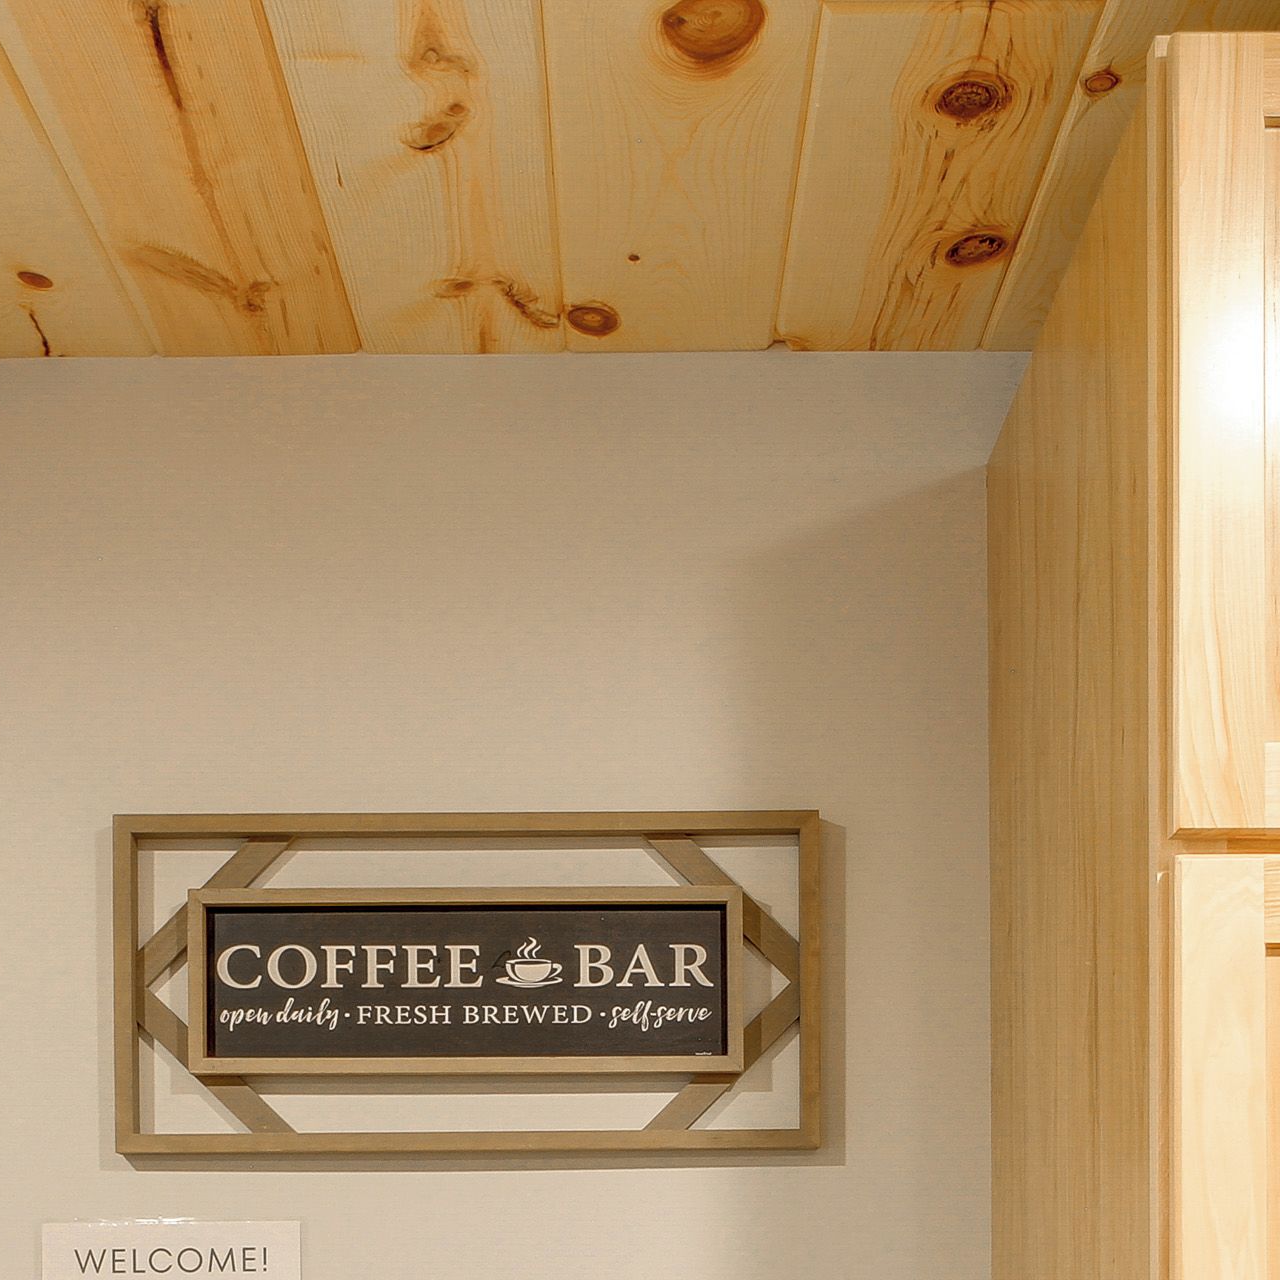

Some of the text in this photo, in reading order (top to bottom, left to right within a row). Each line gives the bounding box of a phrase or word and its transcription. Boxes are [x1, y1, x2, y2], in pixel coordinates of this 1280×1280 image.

[216, 944, 714, 989] COFFEE BAR
[219, 997, 712, 1031] open daily FRESH BREWED self-serve
[74, 1248, 267, 1273] WELCOME!
